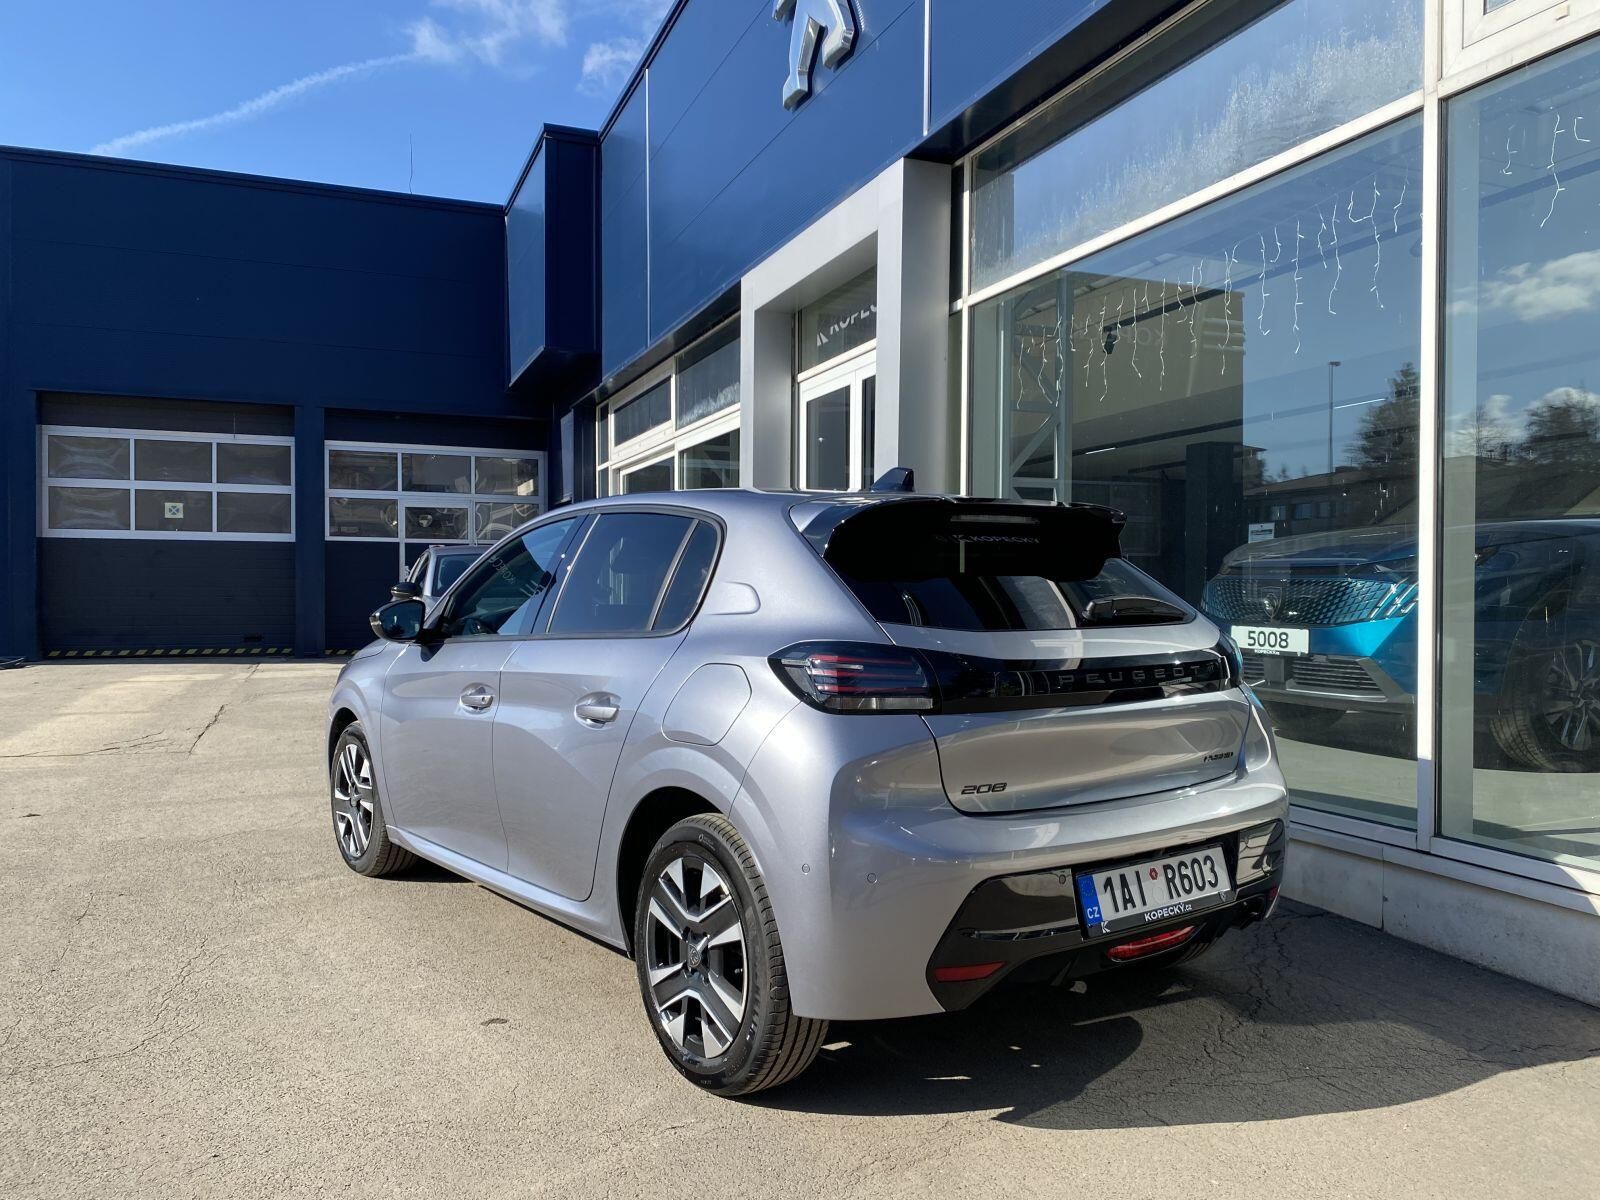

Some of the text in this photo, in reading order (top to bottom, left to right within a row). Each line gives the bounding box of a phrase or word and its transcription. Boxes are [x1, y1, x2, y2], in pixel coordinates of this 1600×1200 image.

[1247, 630, 1289, 648] 5008
[1058, 665, 1200, 688] PEUGEOT
[961, 782, 1007, 795] 208
[1103, 854, 1219, 913] 1AI R603
[1086, 907, 1101, 920] CZ
